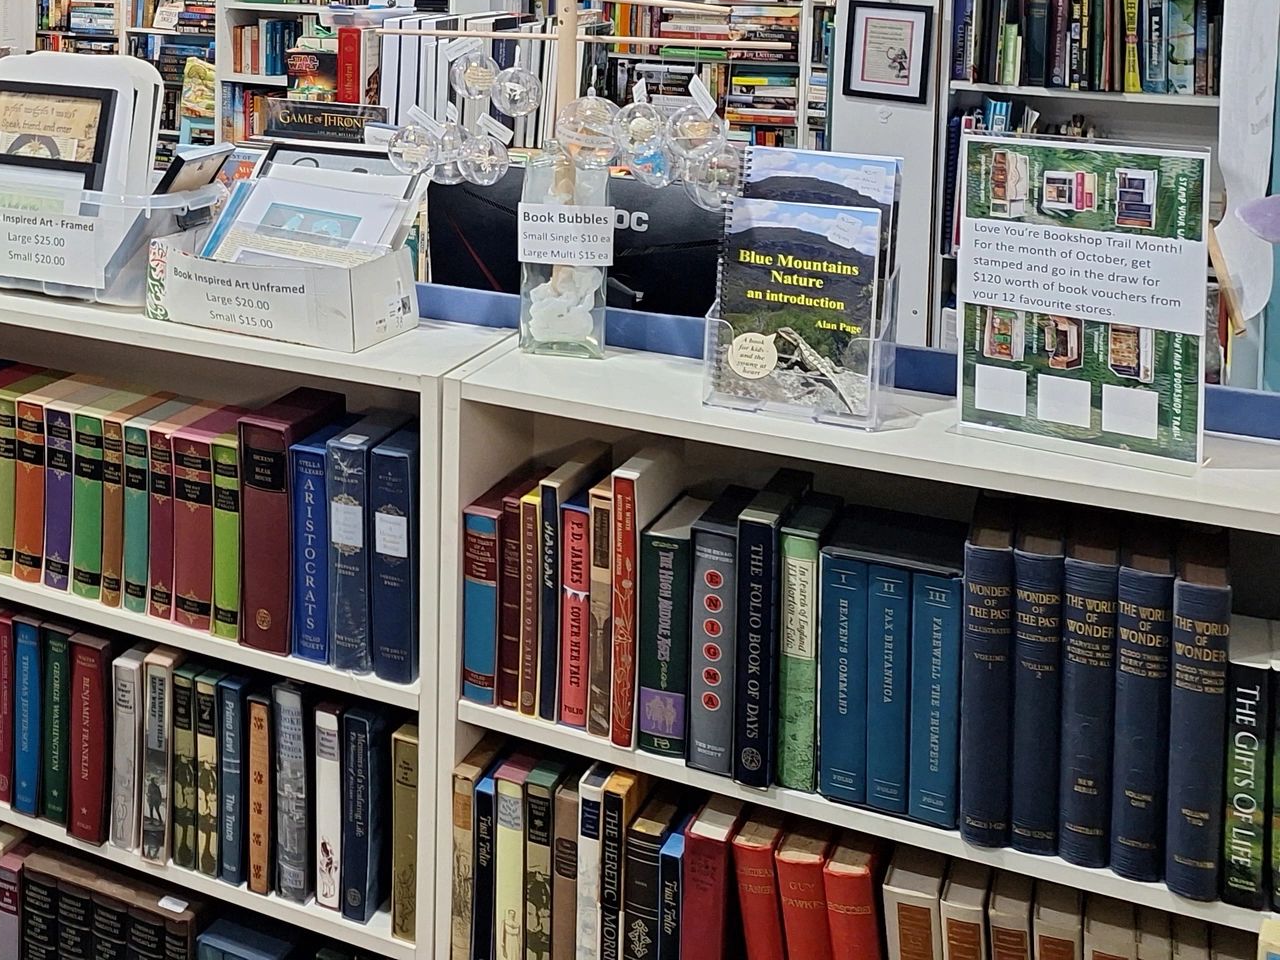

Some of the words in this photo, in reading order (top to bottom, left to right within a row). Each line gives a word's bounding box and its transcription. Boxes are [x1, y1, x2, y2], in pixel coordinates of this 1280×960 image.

[744, 31, 754, 40] Joy
[755, 31, 785, 39] Dettman
[1127, 12, 1137, 32] CHILD
[288, 55, 318, 64] STAR
[955, 25, 965, 74] CHARACTERS
[1071, 42, 1080, 70] TOLKIEN
[287, 62, 319, 71] WARS
[345, 63, 353, 100] Cathedral
[279, 110, 313, 124] GAME
[1177, 177, 1188, 203] STAMP
[3, 213, 37, 228] Inspired
[39, 217, 53, 226] Art
[60, 220, 94, 232] Framed
[523, 211, 554, 224] Book
[558, 212, 609, 225] Bubbles
[1177, 205, 1186, 226] YOUR
[8, 232, 33, 246] Large
[34, 234, 65, 248] $25.00
[523, 231, 548, 243] Small
[550, 232, 578, 246] Single
[581, 233, 599, 244] $10
[600, 235, 611, 243] ea
[974, 223, 1000, 235] Love
[1004, 226, 1040, 239] You're
[1043, 230, 1103, 246] Bookshop
[1106, 236, 1132, 249] Trail
[1135, 240, 1183, 254] Month!
[8, 251, 32, 262] Small
[35, 253, 65, 266] $20.00
[523, 248, 547, 261] Large
[550, 249, 576, 260] Multi
[578, 250, 596, 261] $15
[598, 252, 609, 260] ea
[738, 249, 773, 266] Blue
[777, 254, 860, 276] Mountains
[974, 239, 993, 251] For
[995, 242, 1015, 253] the
[1018, 245, 1057, 257] month
[1060, 248, 1072, 259] of
[1076, 251, 1128, 267] October,
[1131, 258, 1151, 270] get
[173, 267, 193, 281] Book
[194, 273, 232, 288] Inspired
[234, 279, 250, 290] Art
[252, 282, 305, 294] Unframed
[770, 270, 824, 289] Nature
[973, 257, 1023, 271] stamped
[1026, 262, 1048, 274] and
[1051, 267, 1066, 277] go
[1070, 266, 1080, 277] in
[1084, 267, 1105, 279] the
[1108, 270, 1138, 284] draw
[1142, 275, 1160, 287] for
[206, 293, 233, 307] Large
[234, 296, 270, 311] $20.00
[746, 290, 763, 300] an
[766, 290, 845, 311] introduction
[973, 271, 1001, 285] $120
[1004, 275, 1040, 288] worth
[1043, 279, 1055, 291] of
[1058, 282, 1088, 295] book
[1092, 285, 1147, 303] vouchers
[1150, 293, 1181, 307] from
[972, 290, 998, 303] your
[1002, 291, 1016, 302] 12
[1019, 293, 1072, 310] favourite
[1075, 301, 1116, 317] stores.
[210, 310, 236, 323] Small
[238, 314, 273, 329] $15.00
[815, 320, 837, 331] Alan
[839, 322, 862, 335] Page
[1173, 333, 1184, 370] OUNTAINS
[1172, 372, 1183, 414] BOOKSHOP
[1172, 416, 1183, 441] TRAIL!
[303, 479, 316, 630] ARISTOCRATS
[570, 546, 582, 584] JAMES
[751, 544, 763, 576] THE
[750, 582, 762, 628] FOLIO
[570, 606, 582, 637] COVER
[570, 640, 581, 661] HER
[705, 573, 720, 708] ENIGMA
[748, 633, 760, 675] BOOK
[52, 662, 60, 702] GEORGE
[569, 664, 581, 688] FACE
[747, 680, 759, 699] OF
[226, 700, 235, 730] Primo
[1234, 684, 1260, 727] THE
[746, 703, 759, 739] DAYS
[51, 704, 60, 771] WASHINGTON
[226, 732, 235, 753] Levi
[1233, 731, 1259, 789] GIFTS
[226, 794, 235, 812] The
[1232, 793, 1256, 824] OF
[226, 815, 234, 841] Truce
[1230, 827, 1256, 868] LIFE
